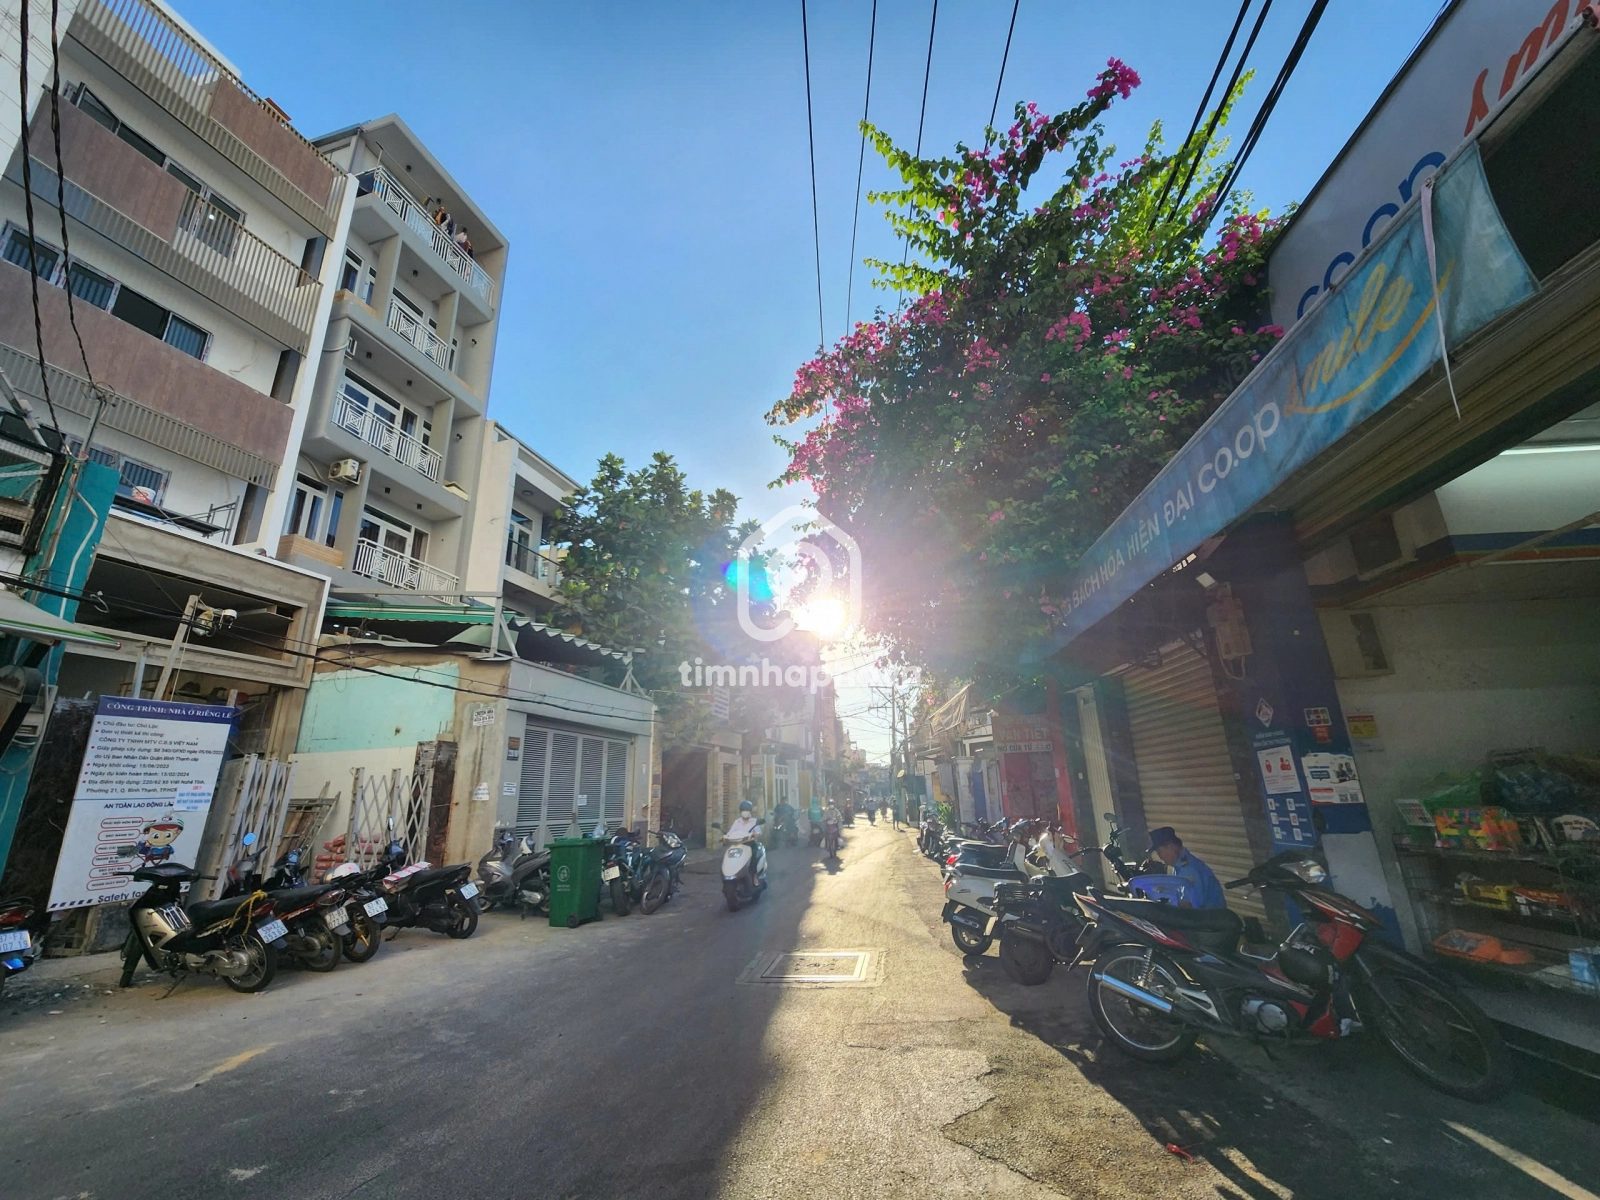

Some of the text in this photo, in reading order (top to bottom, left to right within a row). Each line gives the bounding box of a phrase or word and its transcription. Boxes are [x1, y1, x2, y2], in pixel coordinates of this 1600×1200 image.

[1126, 511, 1161, 561] HIỆN
[1163, 481, 1195, 528] ĐẠI
[106, 701, 134, 711] CÔNG
[135, 704, 166, 713] TRÌNH:
[168, 707, 186, 715] NHÀ
[196, 709, 220, 718] RIÊNG
[98, 892, 130, 903] Safety
[0, 940, 28, 952] 07.19
